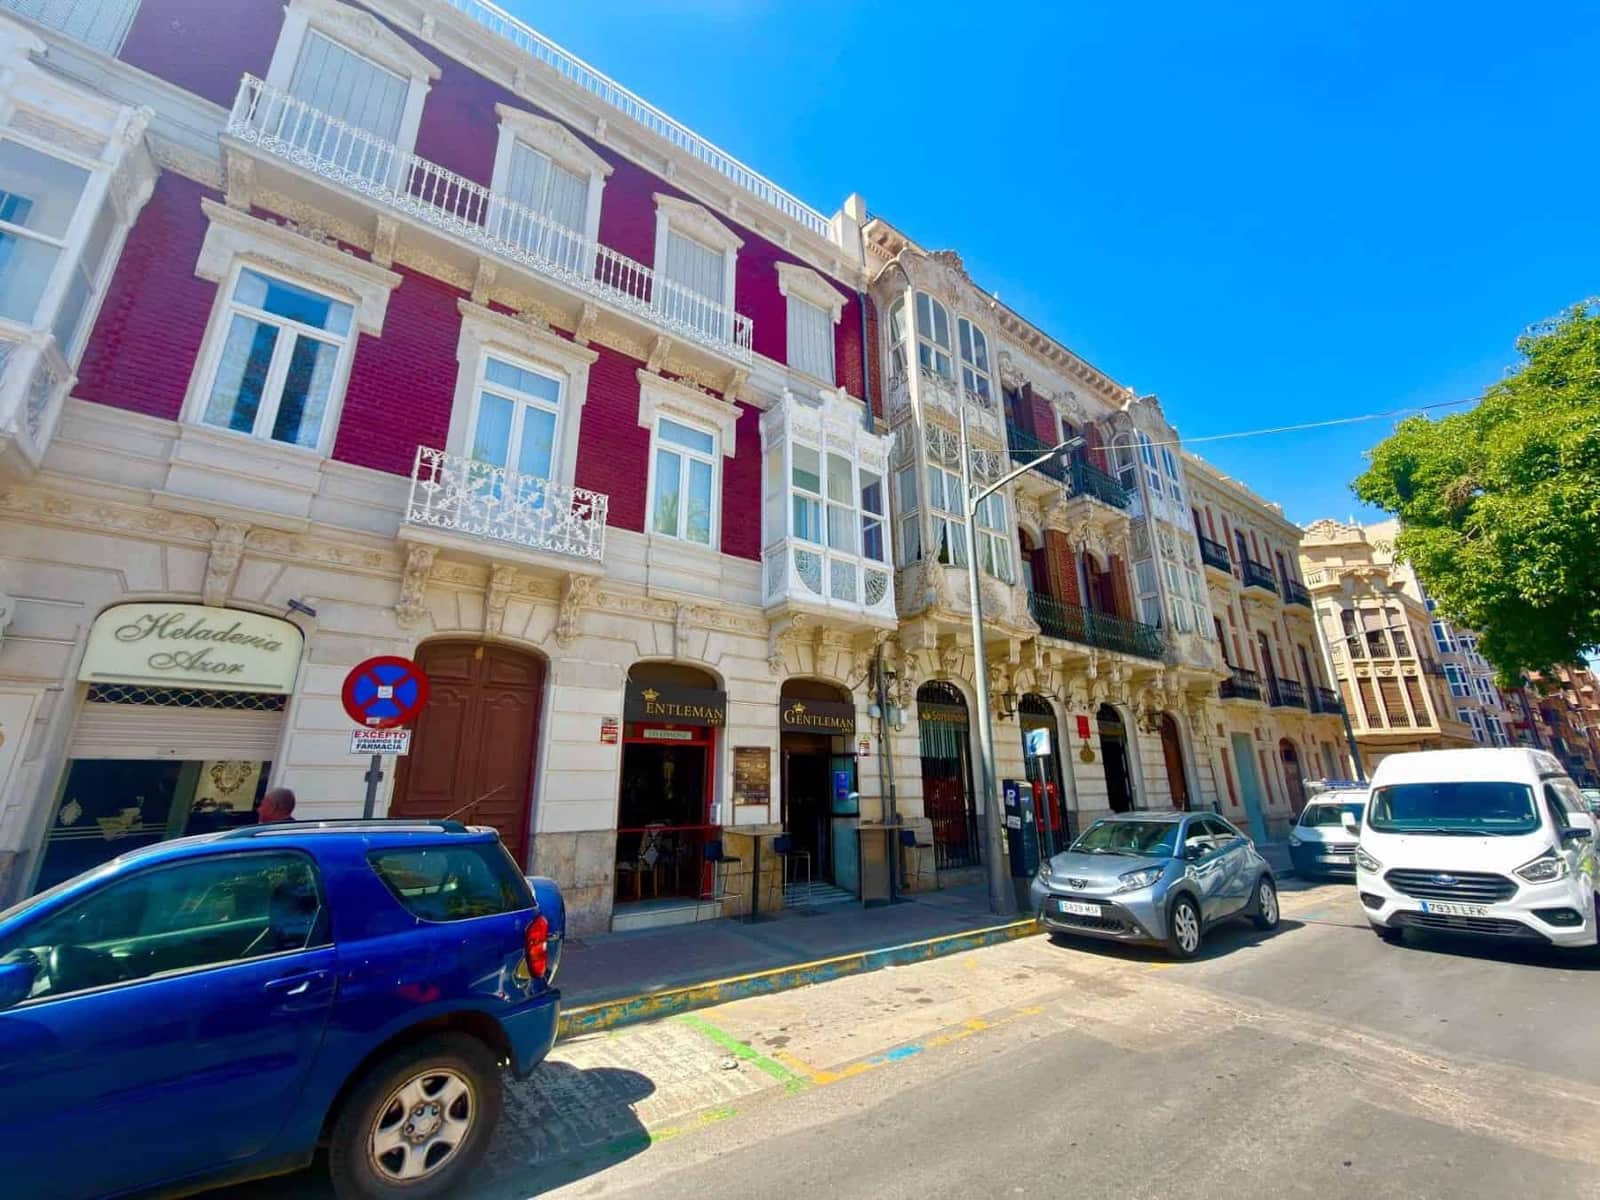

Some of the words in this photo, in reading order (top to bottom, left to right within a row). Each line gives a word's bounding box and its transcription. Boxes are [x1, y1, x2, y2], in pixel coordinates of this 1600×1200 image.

[148, 648, 245, 674] Azor
[646, 702, 723, 719] ENTLEMAN
[784, 709, 854, 728] GENTLEMAN
[354, 730, 407, 739] EXCEPTO
[356, 743, 402, 751] FARMACIA
